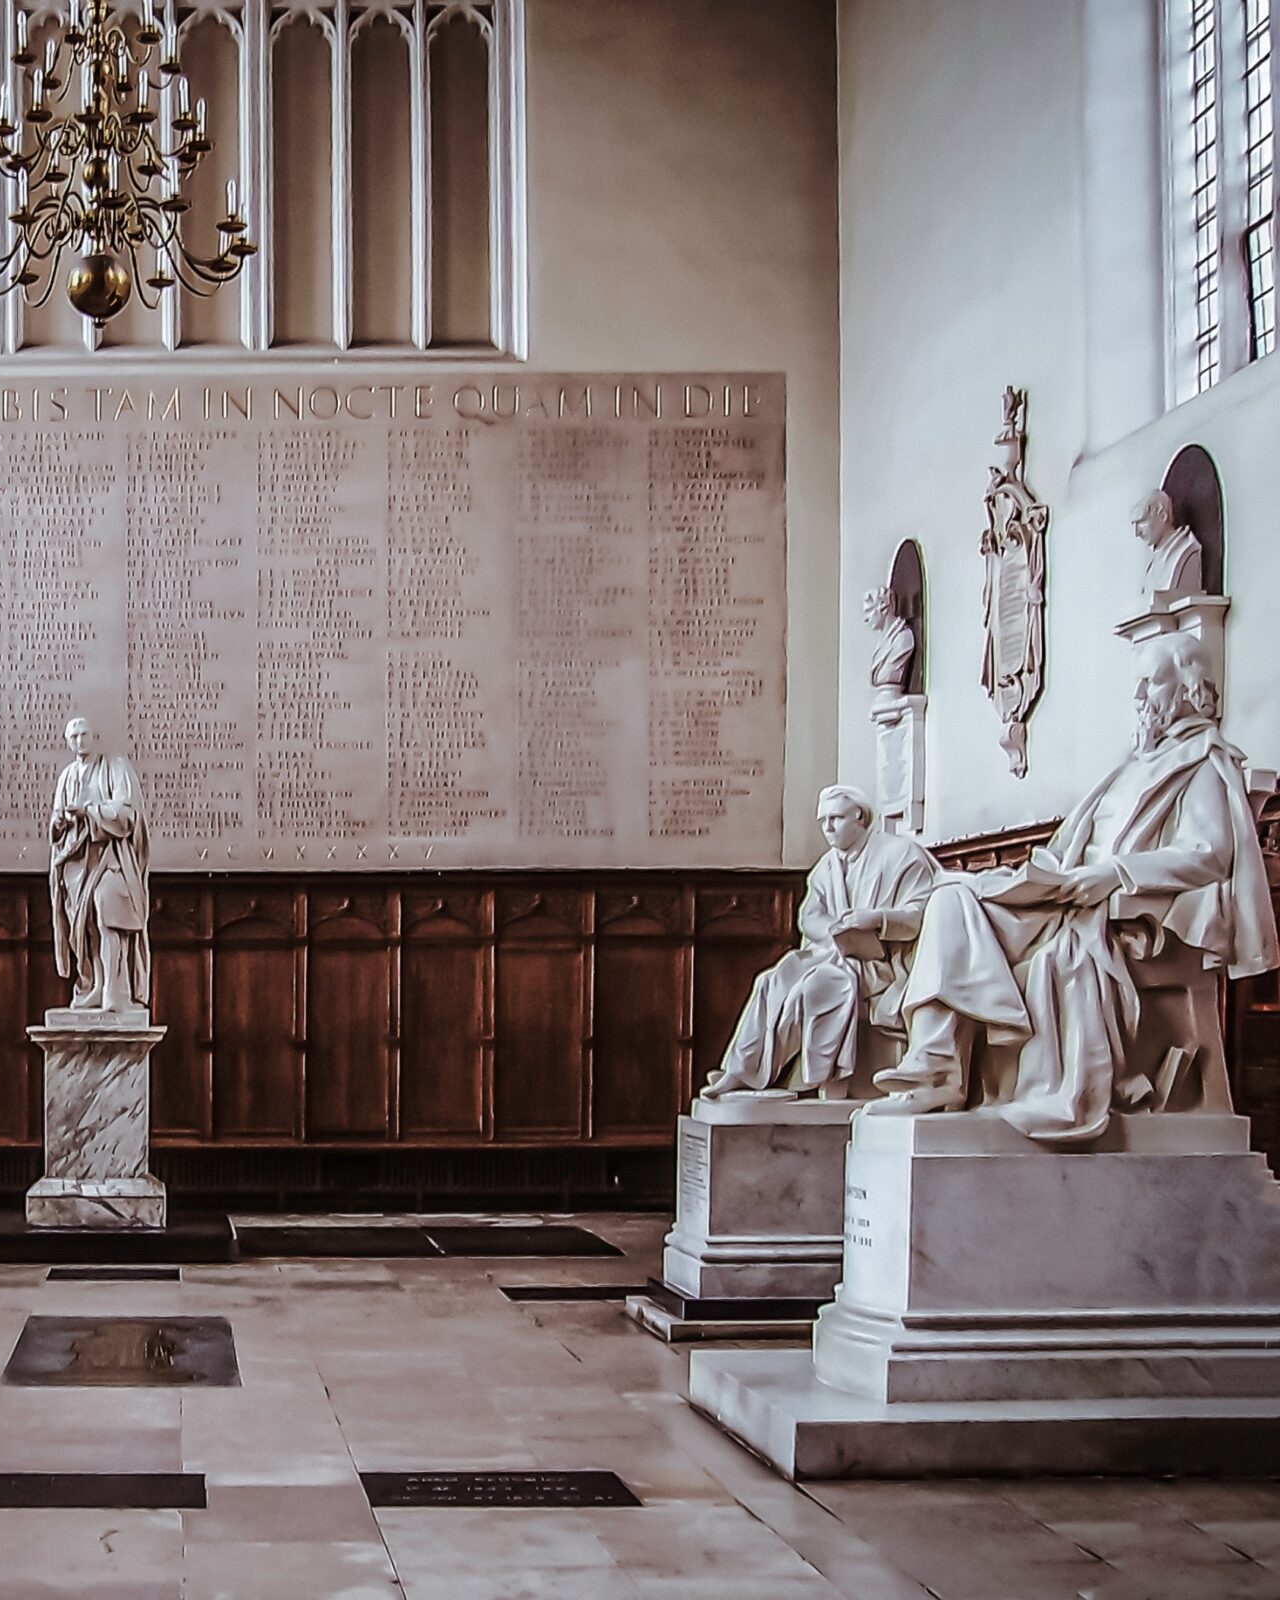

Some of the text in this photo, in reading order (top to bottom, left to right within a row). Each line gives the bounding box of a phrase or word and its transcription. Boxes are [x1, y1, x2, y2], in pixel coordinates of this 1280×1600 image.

[87, 387, 182, 422] TAM
[202, 386, 252, 421] IN
[273, 385, 434, 420] NOCTE
[452, 384, 592, 426] QUAM
[614, 383, 662, 419] IN
[683, 382, 762, 419] DIE
